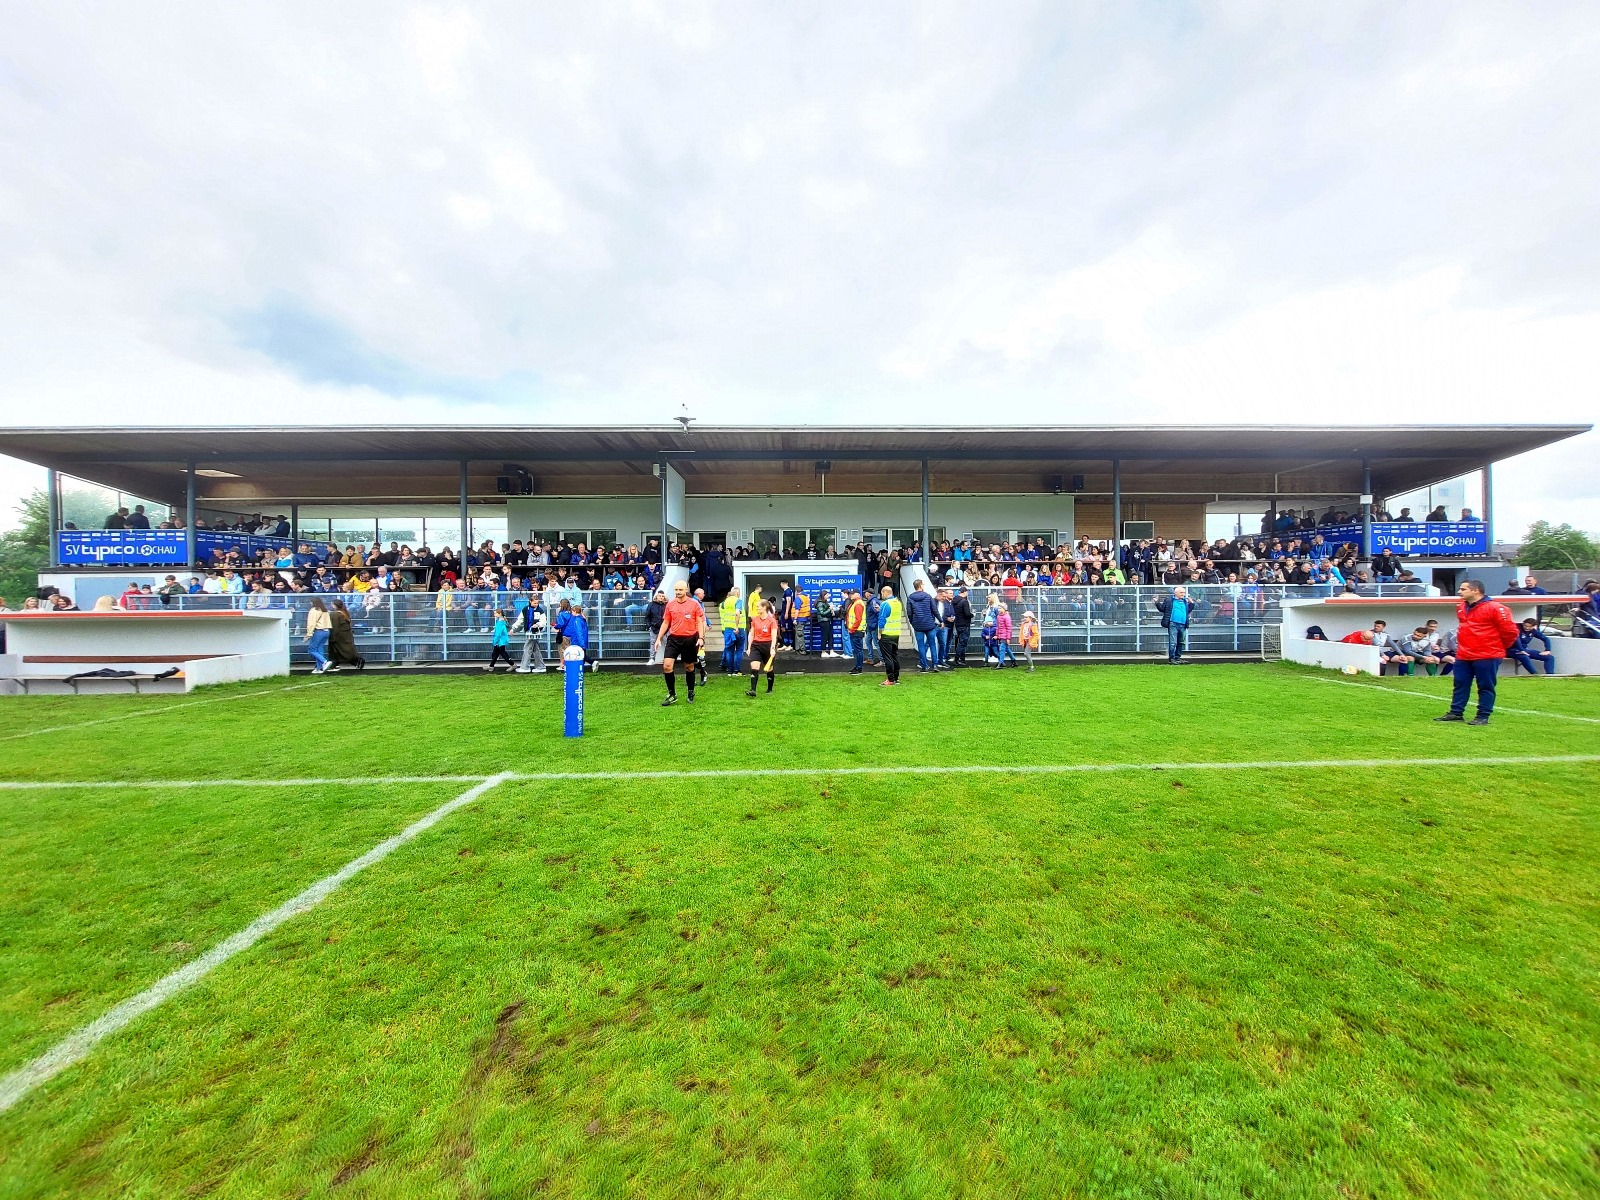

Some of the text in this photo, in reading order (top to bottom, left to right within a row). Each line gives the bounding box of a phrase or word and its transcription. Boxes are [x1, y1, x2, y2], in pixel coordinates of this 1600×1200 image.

[1377, 536, 1476, 551] SV typico LOCHAU
[65, 544, 177, 560] SV typico LOCHAU
[811, 578, 836, 587] typico
[575, 681, 583, 710] typico
